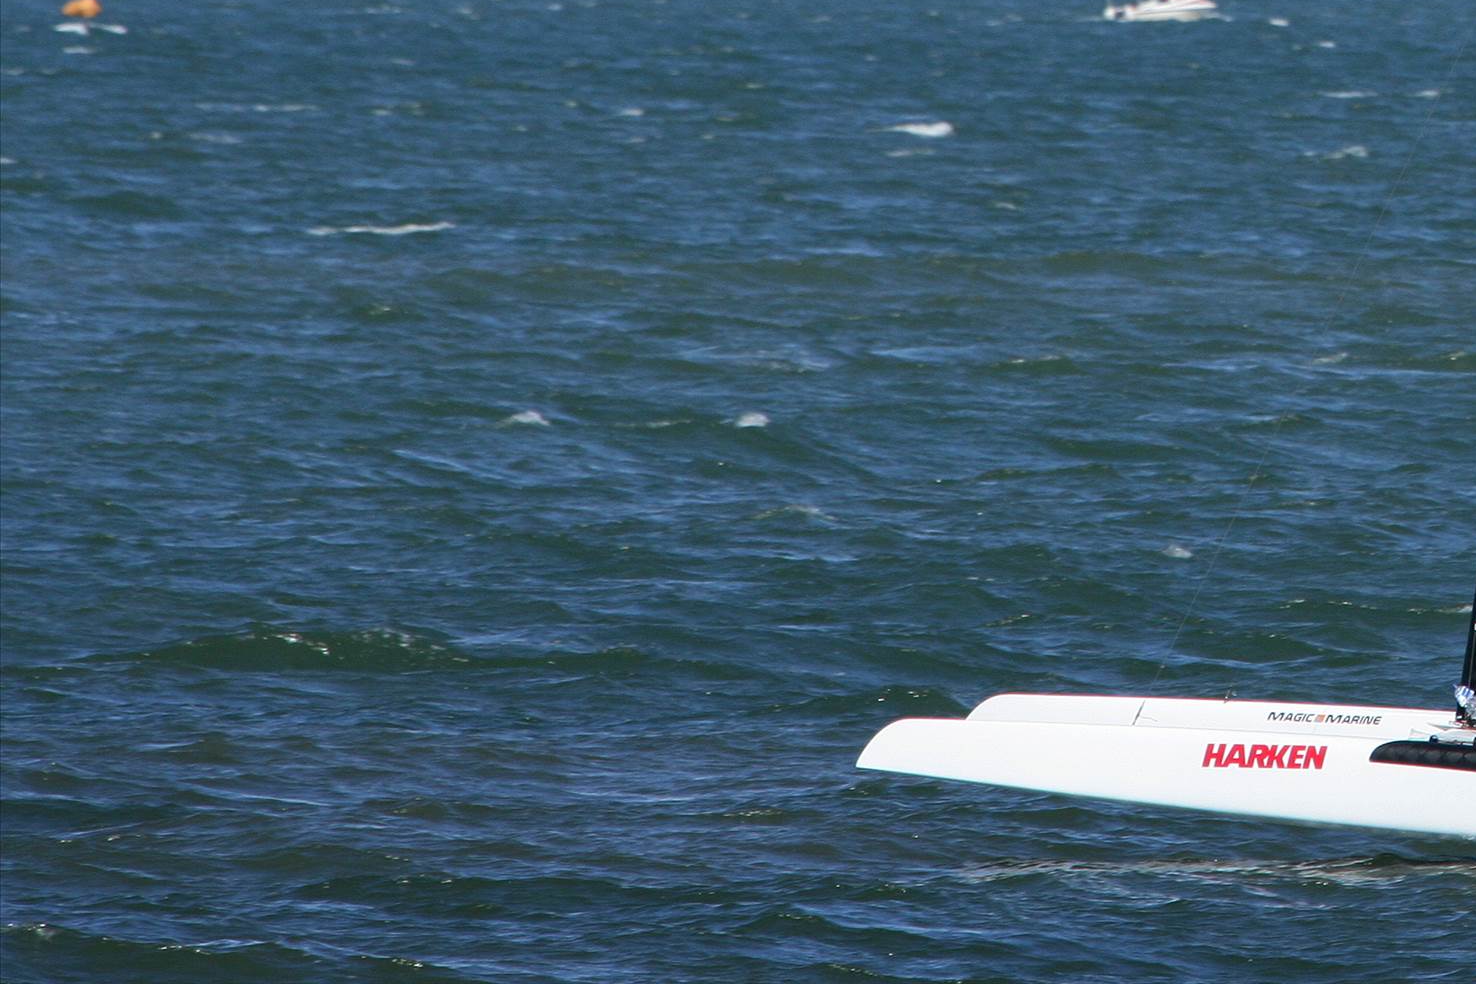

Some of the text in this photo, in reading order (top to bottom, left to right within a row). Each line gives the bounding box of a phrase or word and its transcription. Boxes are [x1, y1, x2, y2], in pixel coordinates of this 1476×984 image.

[1267, 711, 1382, 725] MAGIC MARINE
[1202, 743, 1328, 769] HARKEN
